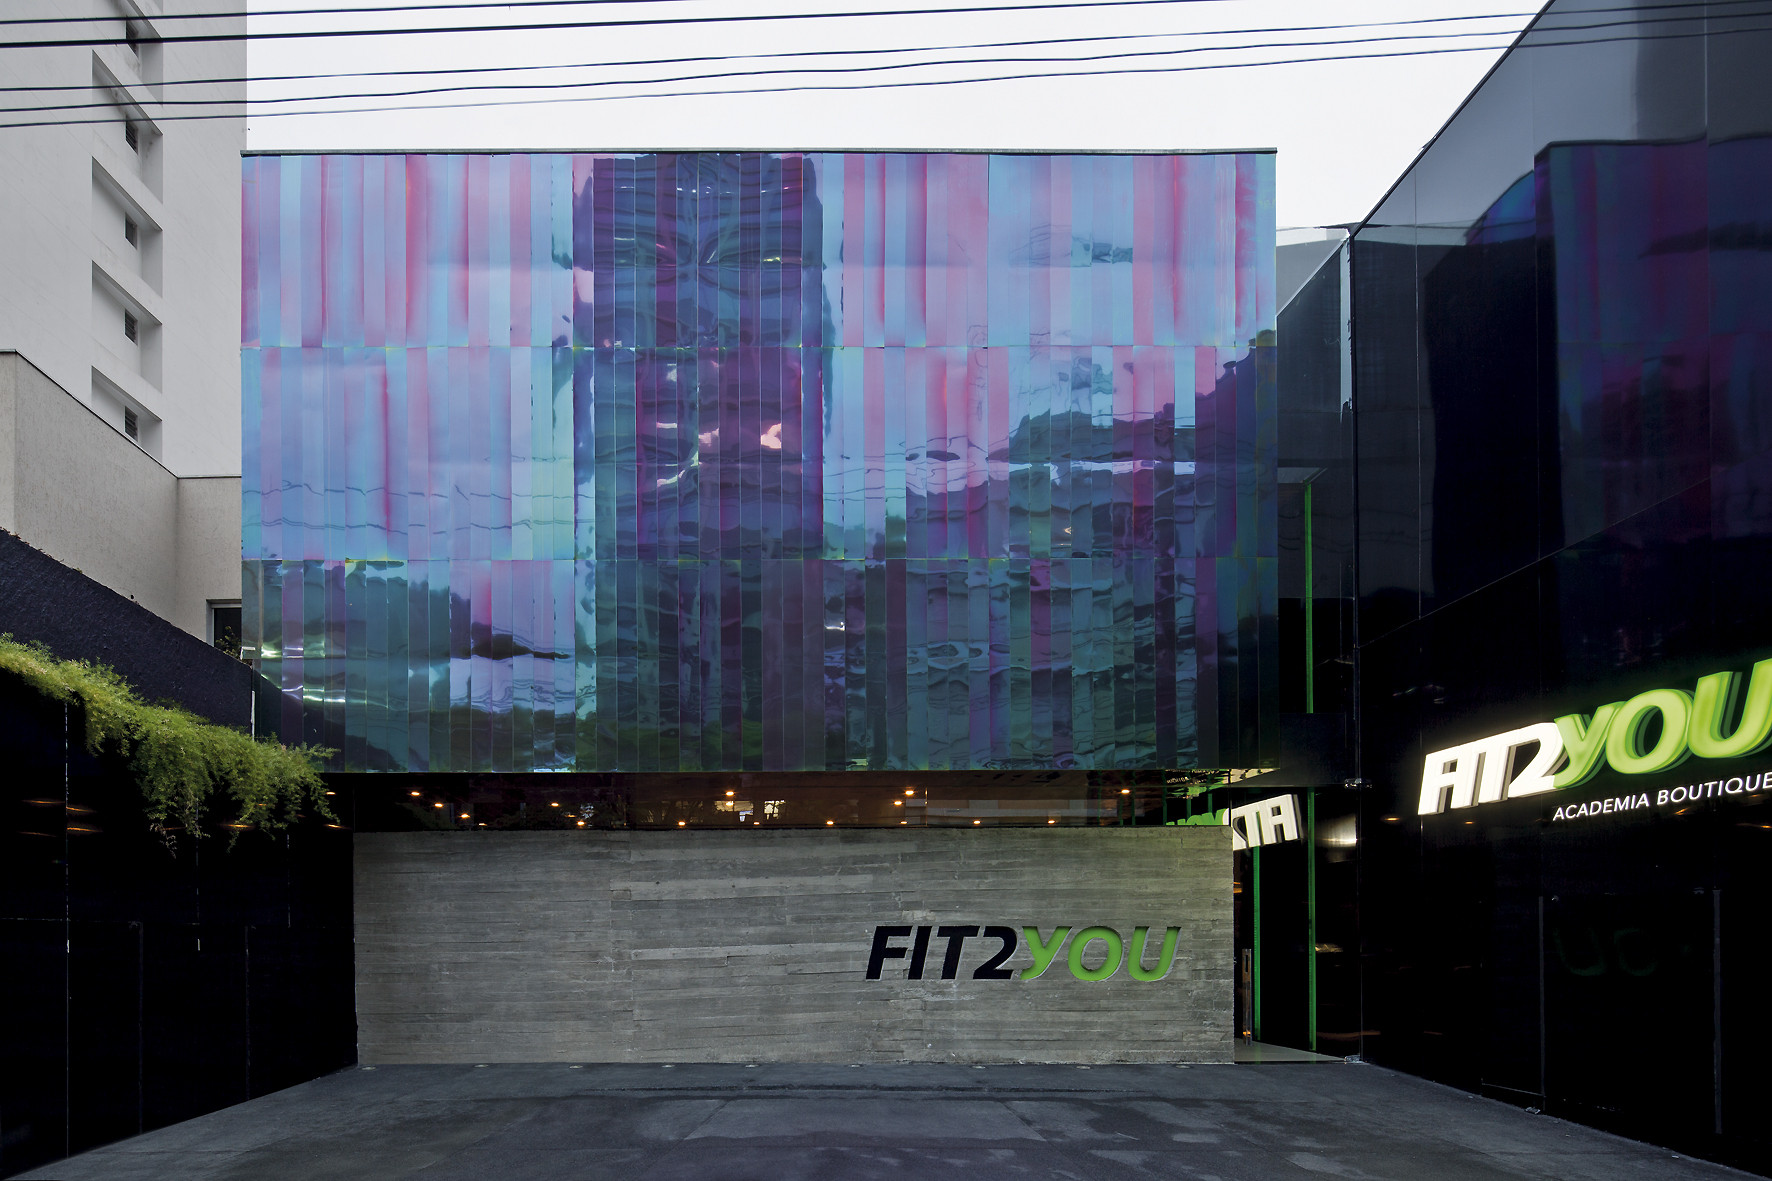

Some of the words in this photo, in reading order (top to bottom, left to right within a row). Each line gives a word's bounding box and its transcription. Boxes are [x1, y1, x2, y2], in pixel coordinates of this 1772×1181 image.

[1419, 659, 1772, 815] FIT2YOU
[1553, 792, 1650, 821] ACADEMIA
[1656, 772, 1772, 806] BOUTIQUE
[866, 926, 1182, 982] FIT2YOU
